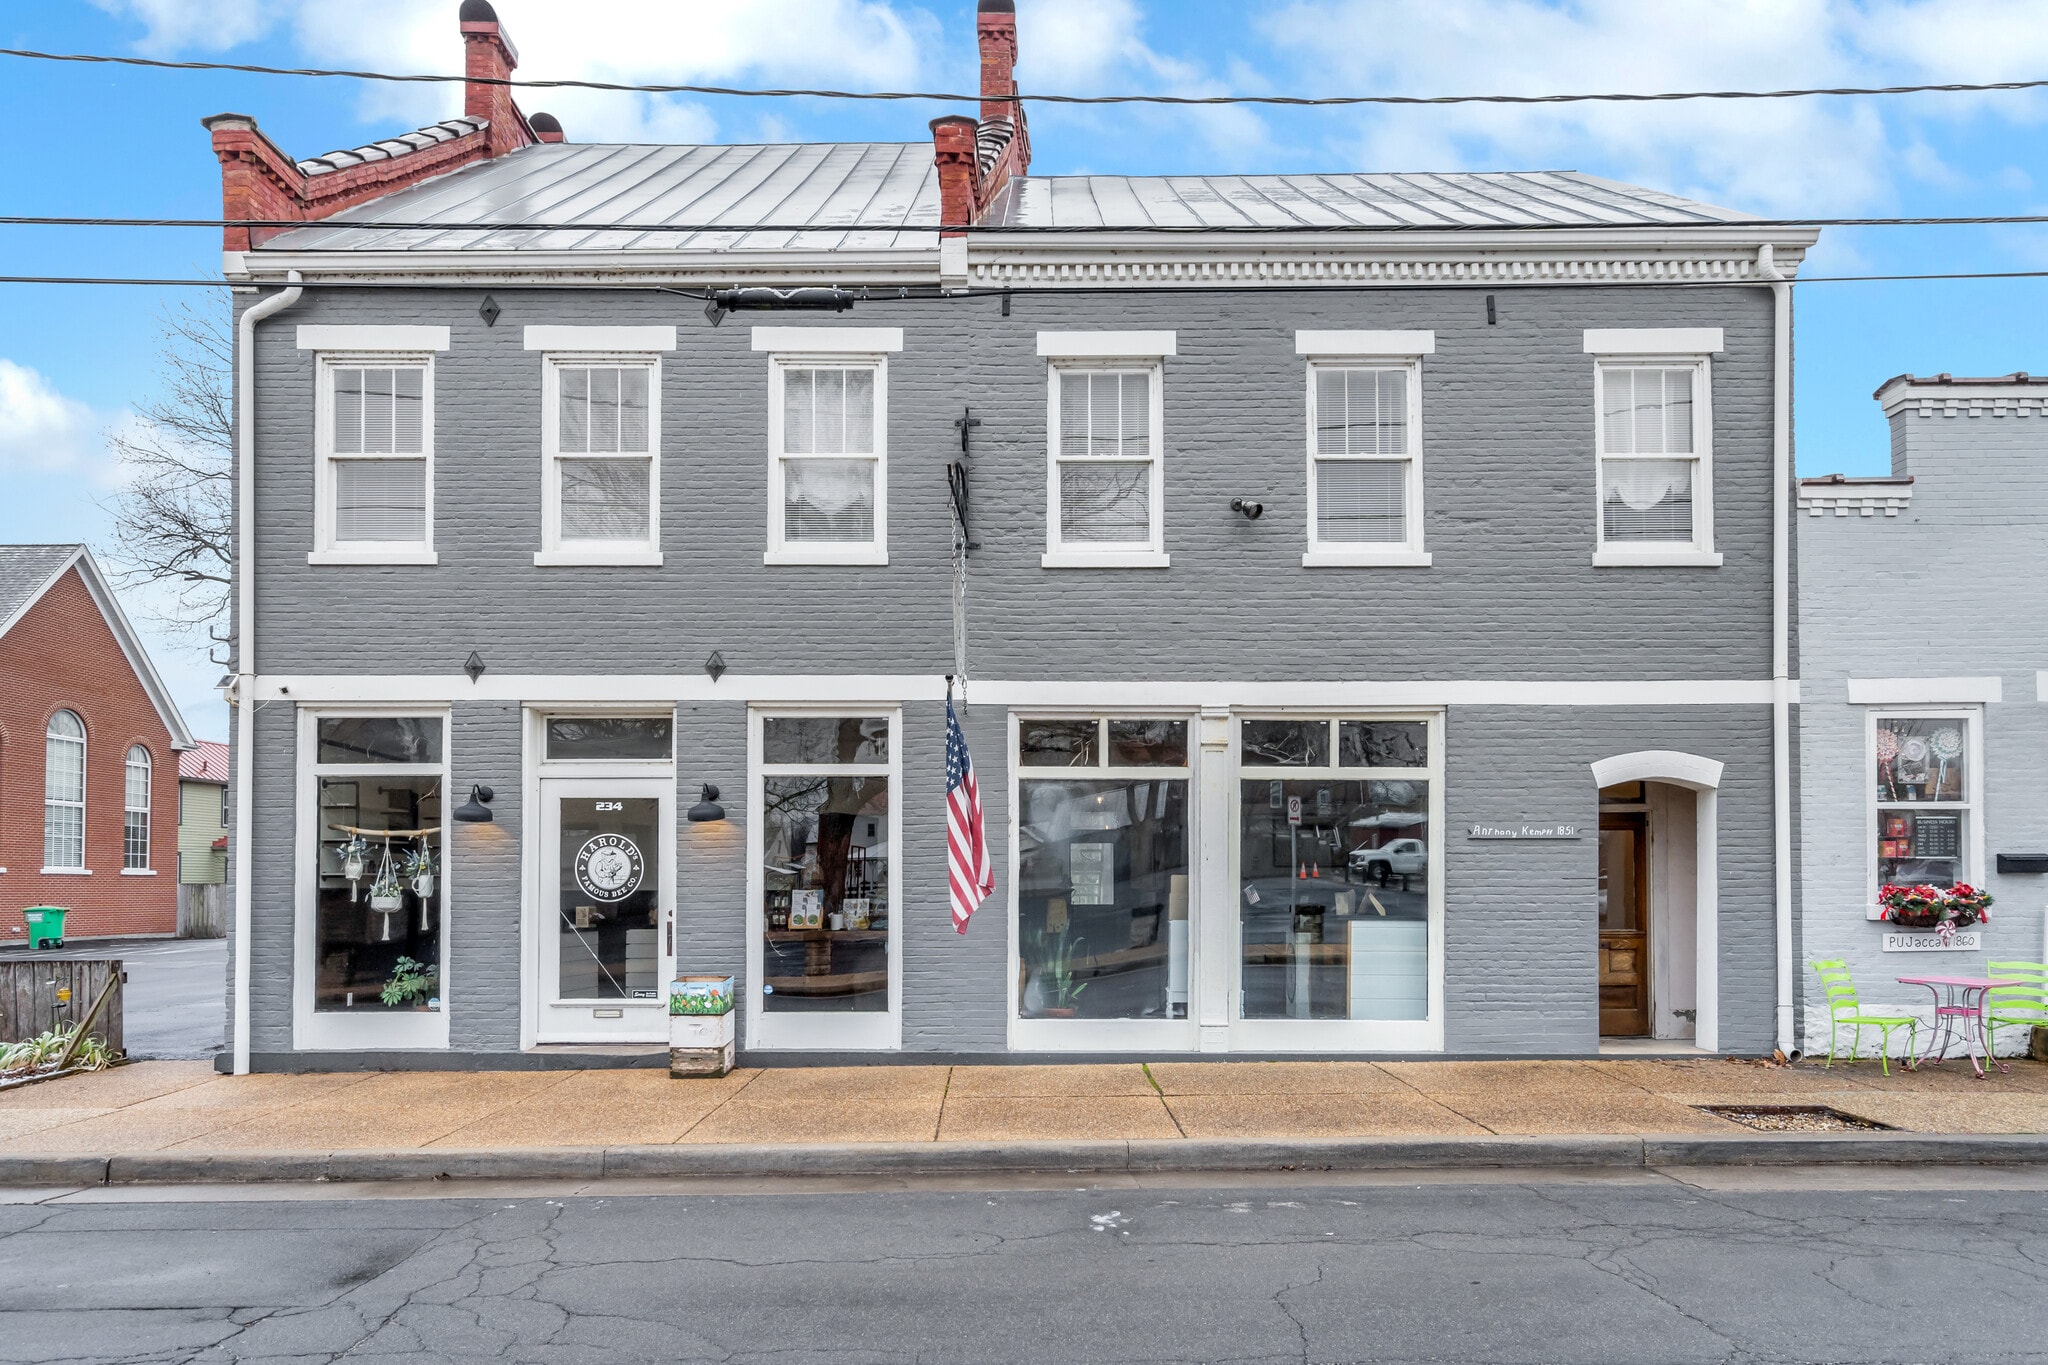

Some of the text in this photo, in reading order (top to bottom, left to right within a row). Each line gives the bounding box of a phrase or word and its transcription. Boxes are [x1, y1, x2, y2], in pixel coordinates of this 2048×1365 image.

[595, 801, 623, 811] 234
[1557, 826, 1574, 836] 1851
[581, 875, 638, 898] FAMOUS BEE CO.
[1953, 935, 1975, 947] 1860
